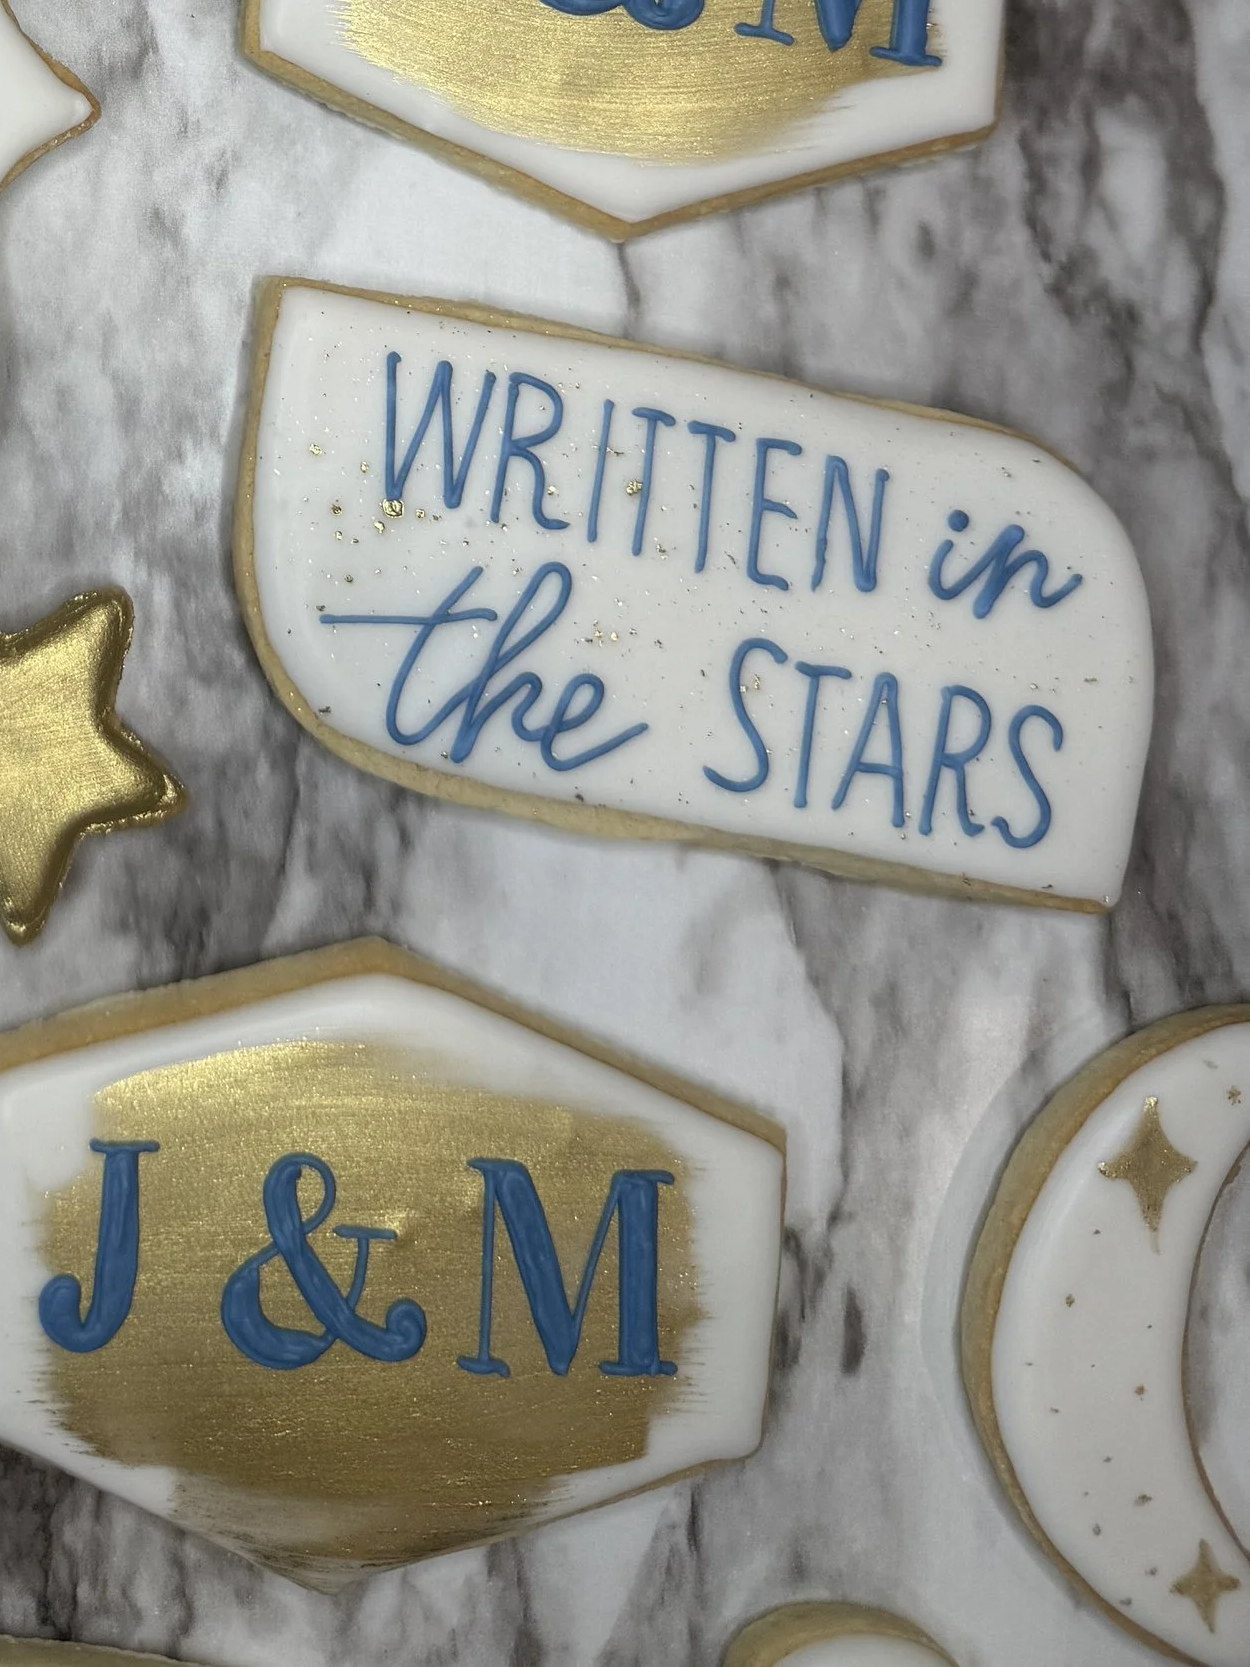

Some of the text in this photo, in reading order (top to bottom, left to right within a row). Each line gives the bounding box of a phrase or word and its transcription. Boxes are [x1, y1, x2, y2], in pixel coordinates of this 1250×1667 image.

[383, 351, 1084, 620] WRITTEN in
[319, 560, 1065, 851] the STARS
[36, 1140, 677, 1378] J & M
